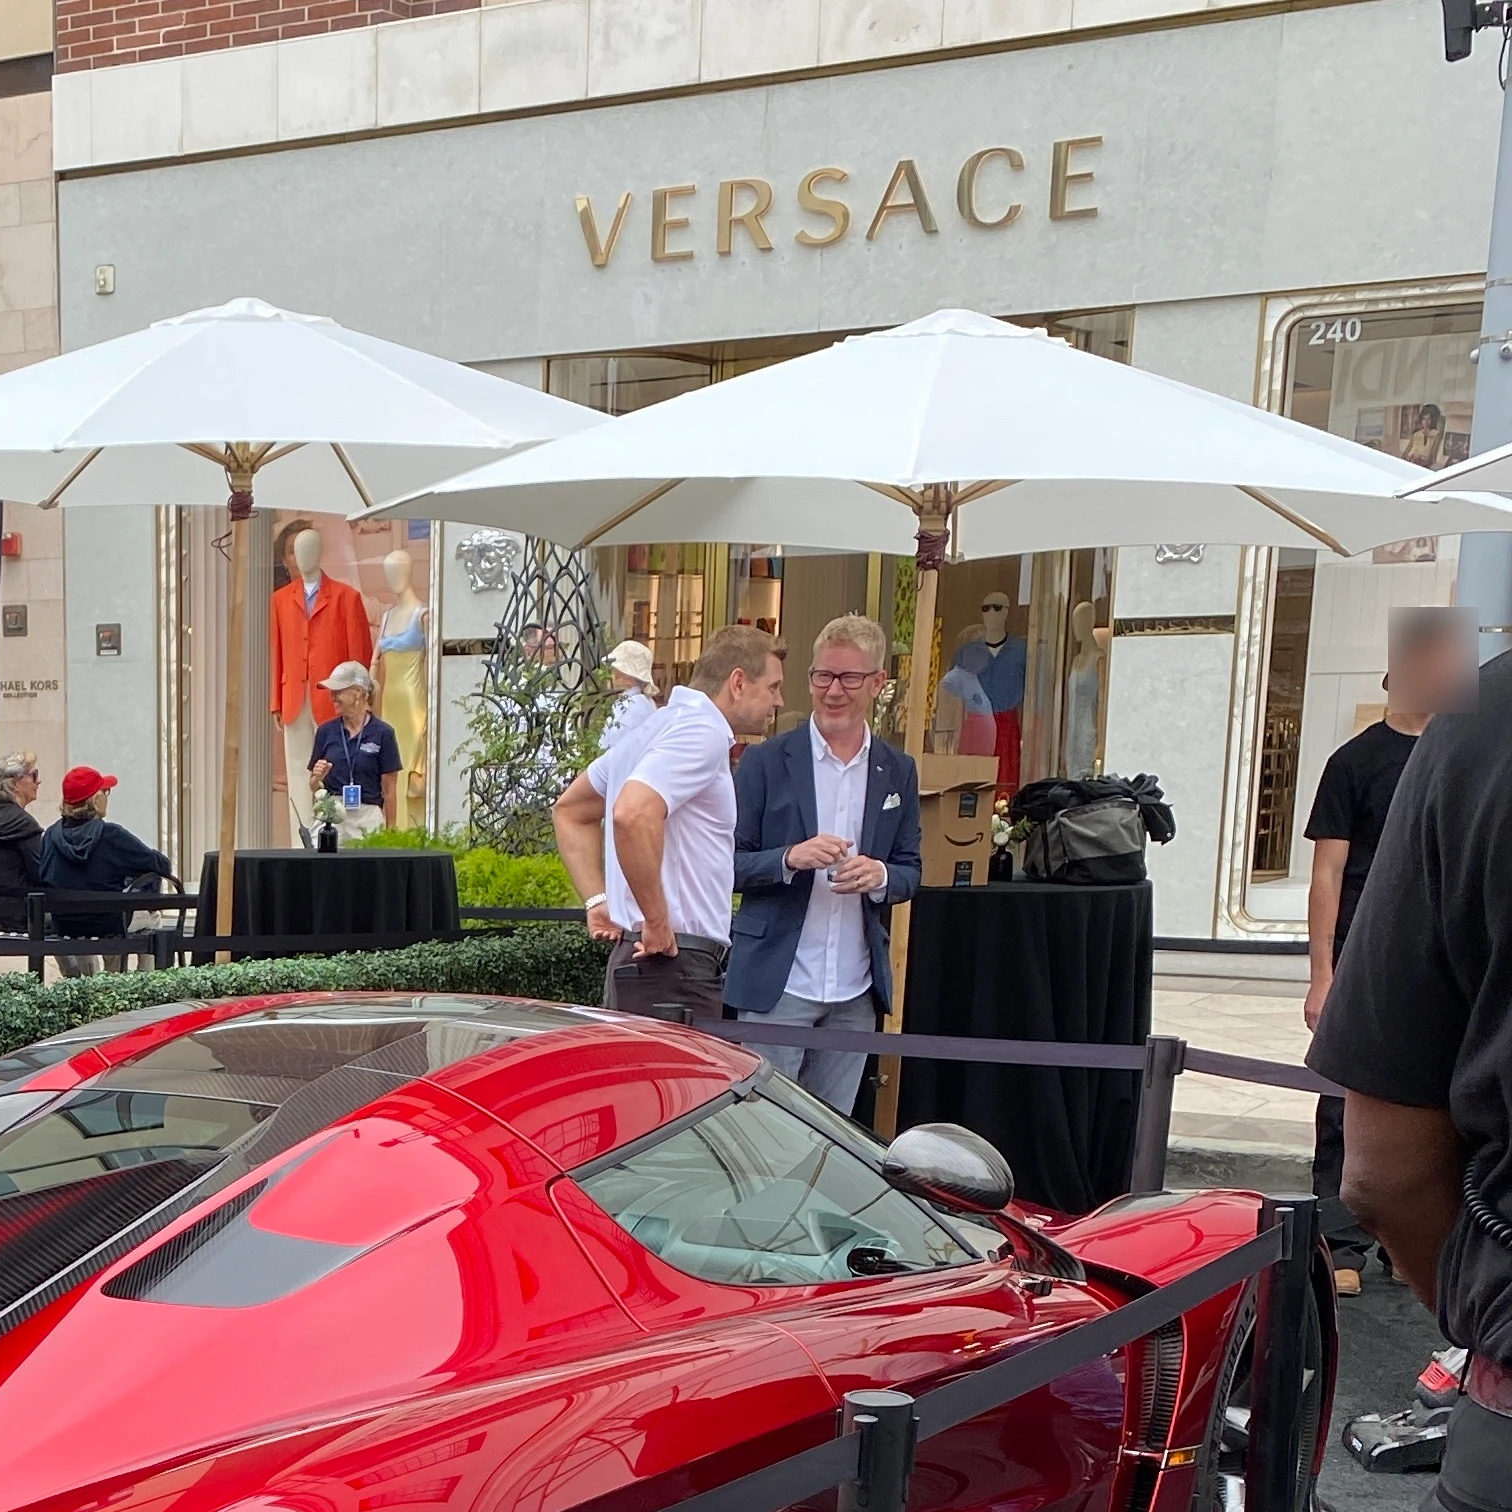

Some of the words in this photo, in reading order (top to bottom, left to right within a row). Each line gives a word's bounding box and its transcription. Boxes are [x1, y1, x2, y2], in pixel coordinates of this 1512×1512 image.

[575, 135, 1104, 267] VERSACE
[1308, 316, 1362, 346] 240
[30, 680, 58, 690] KORS
